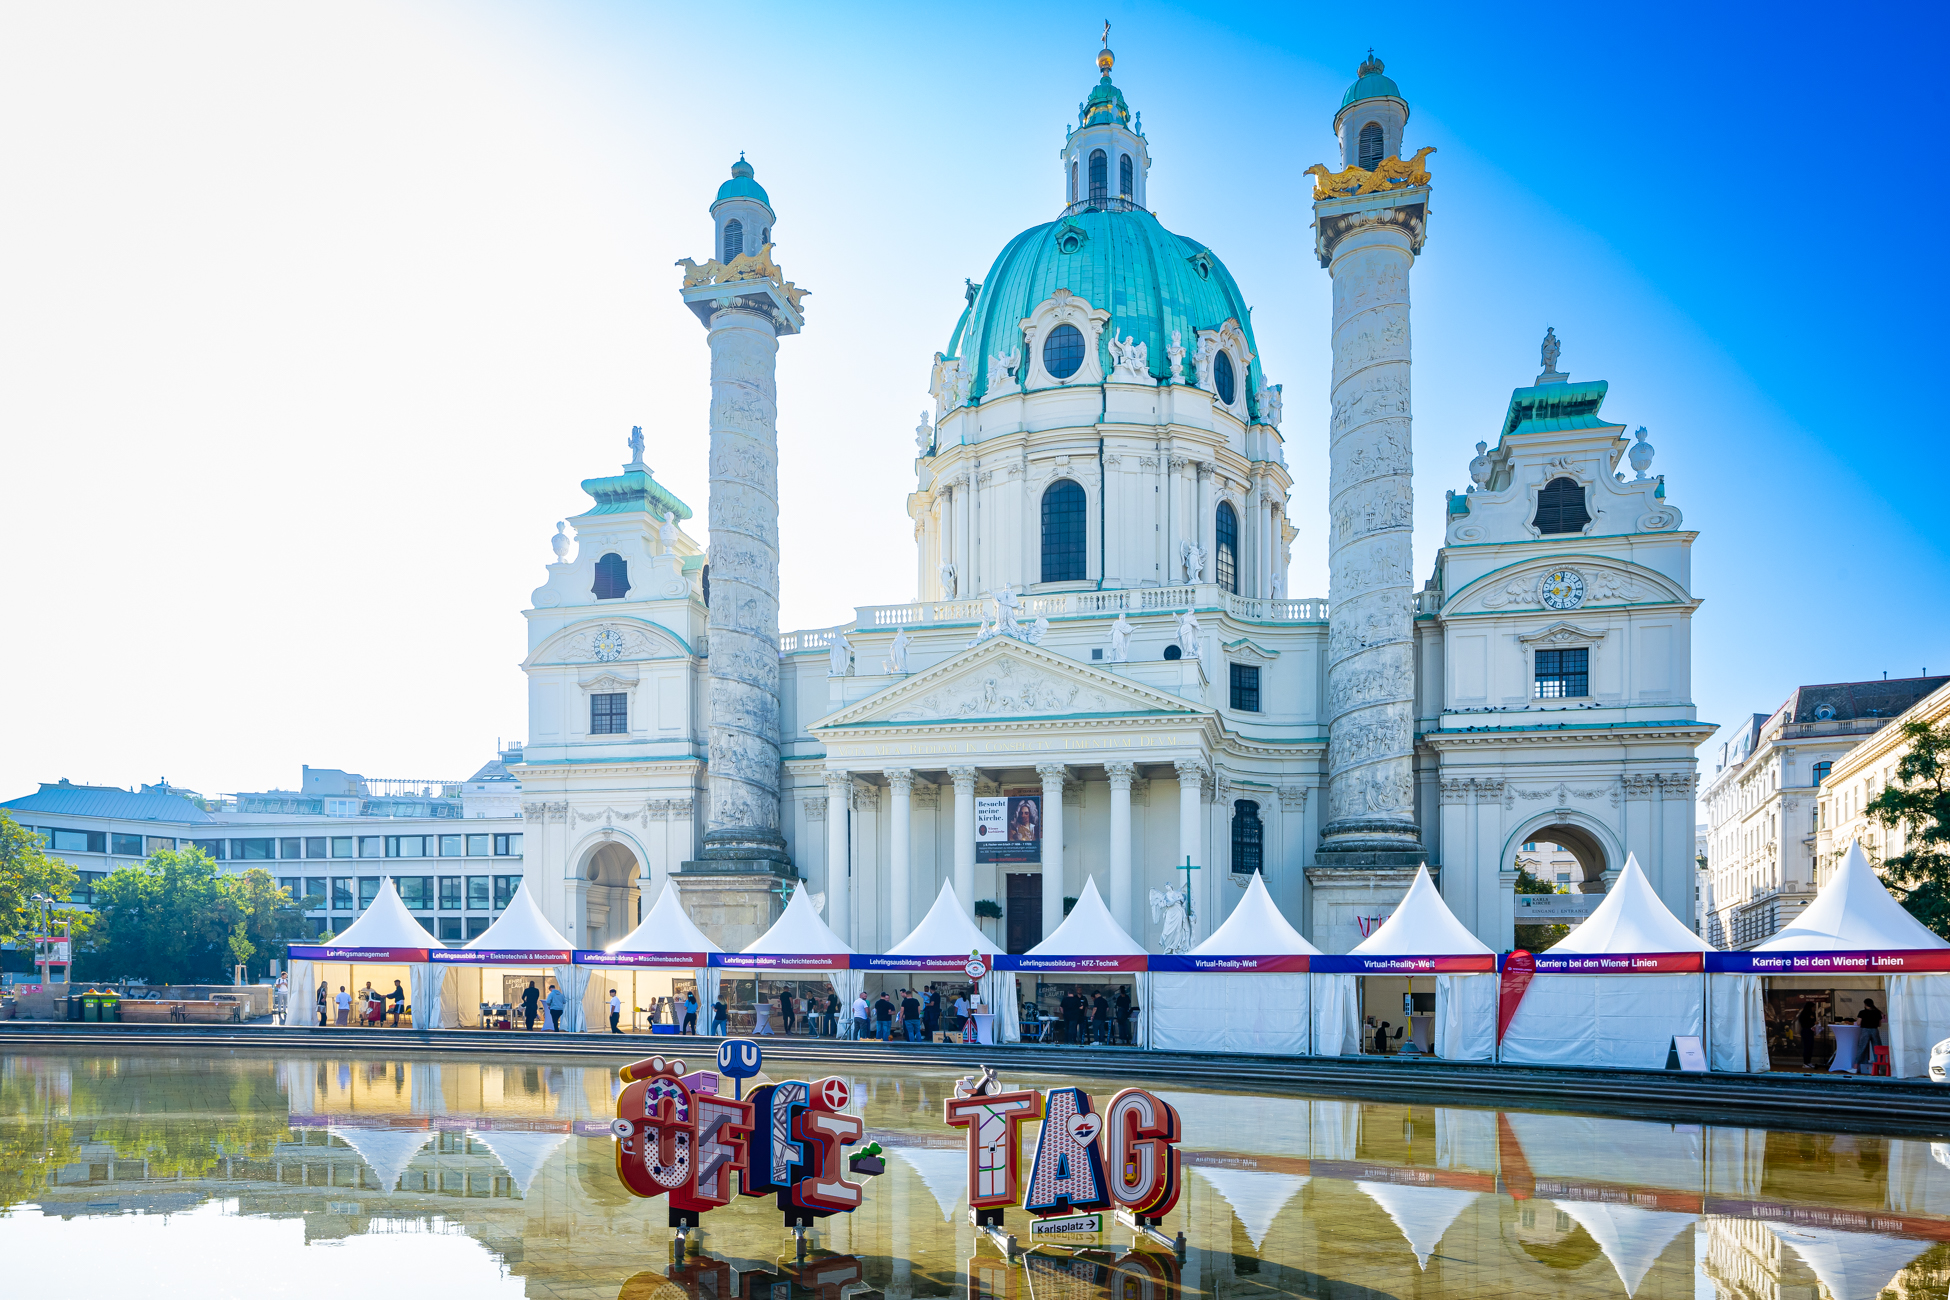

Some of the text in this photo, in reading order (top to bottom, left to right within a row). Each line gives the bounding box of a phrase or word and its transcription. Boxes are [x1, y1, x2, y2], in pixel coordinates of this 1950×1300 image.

[838, 746, 866, 756] VOTA
[875, 745, 901, 756] MEA
[910, 744, 957, 755] REDDAM
[966, 742, 977, 753] IN
[985, 741, 1052, 752] CONSPECTV
[1062, 738, 1131, 749] TIMENTIVM
[1140, 735, 1176, 747] DEVM
[326, 950, 390, 958] Lehrlingsmanagement
[432, 952, 485, 960] Lehrlingsausbildung
[584, 954, 634, 962] Lehrlingsausbildung
[638, 955, 694, 963] Maschinenbautechnik
[724, 957, 776, 965] Lehrlingsausbildung
[869, 959, 921, 967] Lehrlingsausbildung
[1019, 959, 1076, 967] Lehrlingsausbildung
[1195, 959, 1258, 968] Virtual-Reality-Welt
[1364, 960, 1436, 969] Virtual-Reality-Welt
[1535, 958, 1658, 968] Karriere bei den Wiener Linien
[1752, 956, 1904, 966] Karriere bei den Wiener Linien
[719, 1044, 732, 1068] U
[740, 1044, 757, 1067] U
[945, 1087, 1181, 1218] TAG
[1037, 1222, 1084, 1234] Karlsplatz
